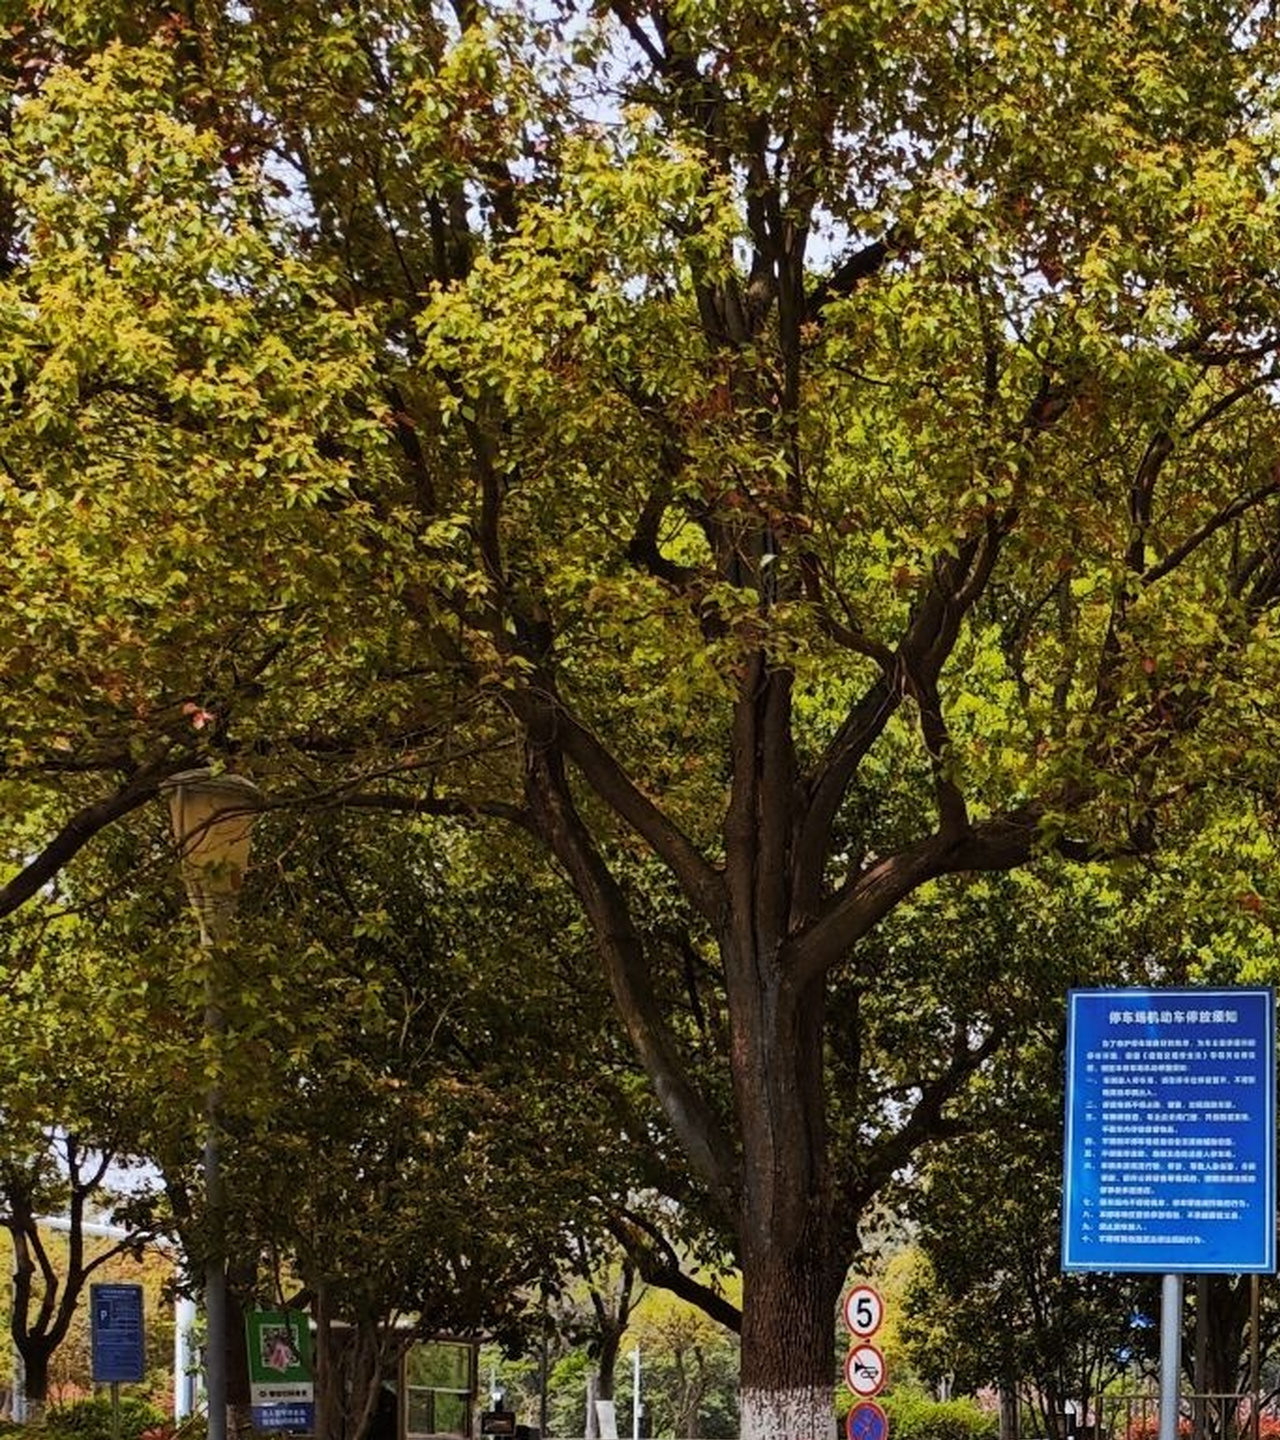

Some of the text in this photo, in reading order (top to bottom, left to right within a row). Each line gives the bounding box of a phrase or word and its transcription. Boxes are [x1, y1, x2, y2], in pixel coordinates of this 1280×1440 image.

[1109, 1010, 1238, 1024] 停车场机动车停放须知
[856, 1298, 873, 1328] 5
